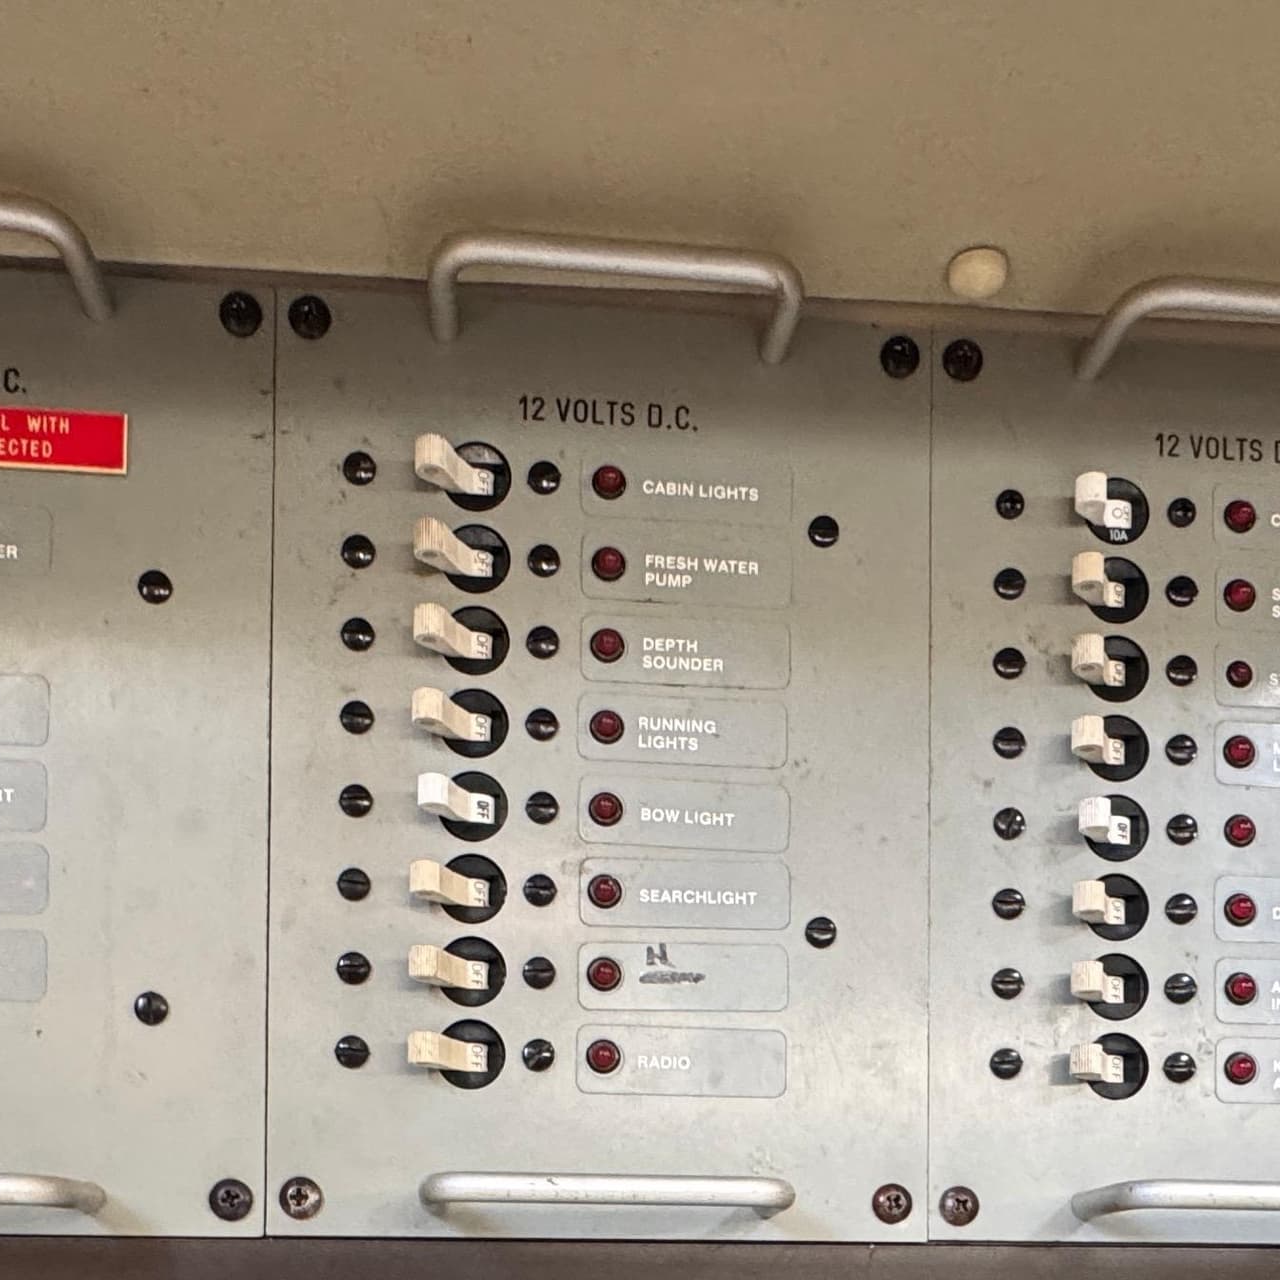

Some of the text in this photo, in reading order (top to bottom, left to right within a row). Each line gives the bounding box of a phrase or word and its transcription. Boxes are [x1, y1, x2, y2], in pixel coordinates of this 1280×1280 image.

[519, 396, 699, 432] 12 VOLTS D.C.
[26, 414, 71, 434] WITH
[1155, 432, 1180, 458] 12
[1189, 435, 1264, 463] VOLTS
[642, 480, 759, 501] CABIN LIGHTS
[645, 554, 759, 576] FRESH WATER
[644, 572, 692, 588] PUMP
[642, 637, 698, 653] DEPTH
[642, 656, 724, 672] SOUNDER
[638, 716, 716, 735] RUNNING
[637, 735, 698, 751] LIGHTS
[640, 807, 735, 827] BOW LIGHT
[639, 889, 757, 906] SEARCHLIGHT
[637, 1054, 691, 1070] RADIO
